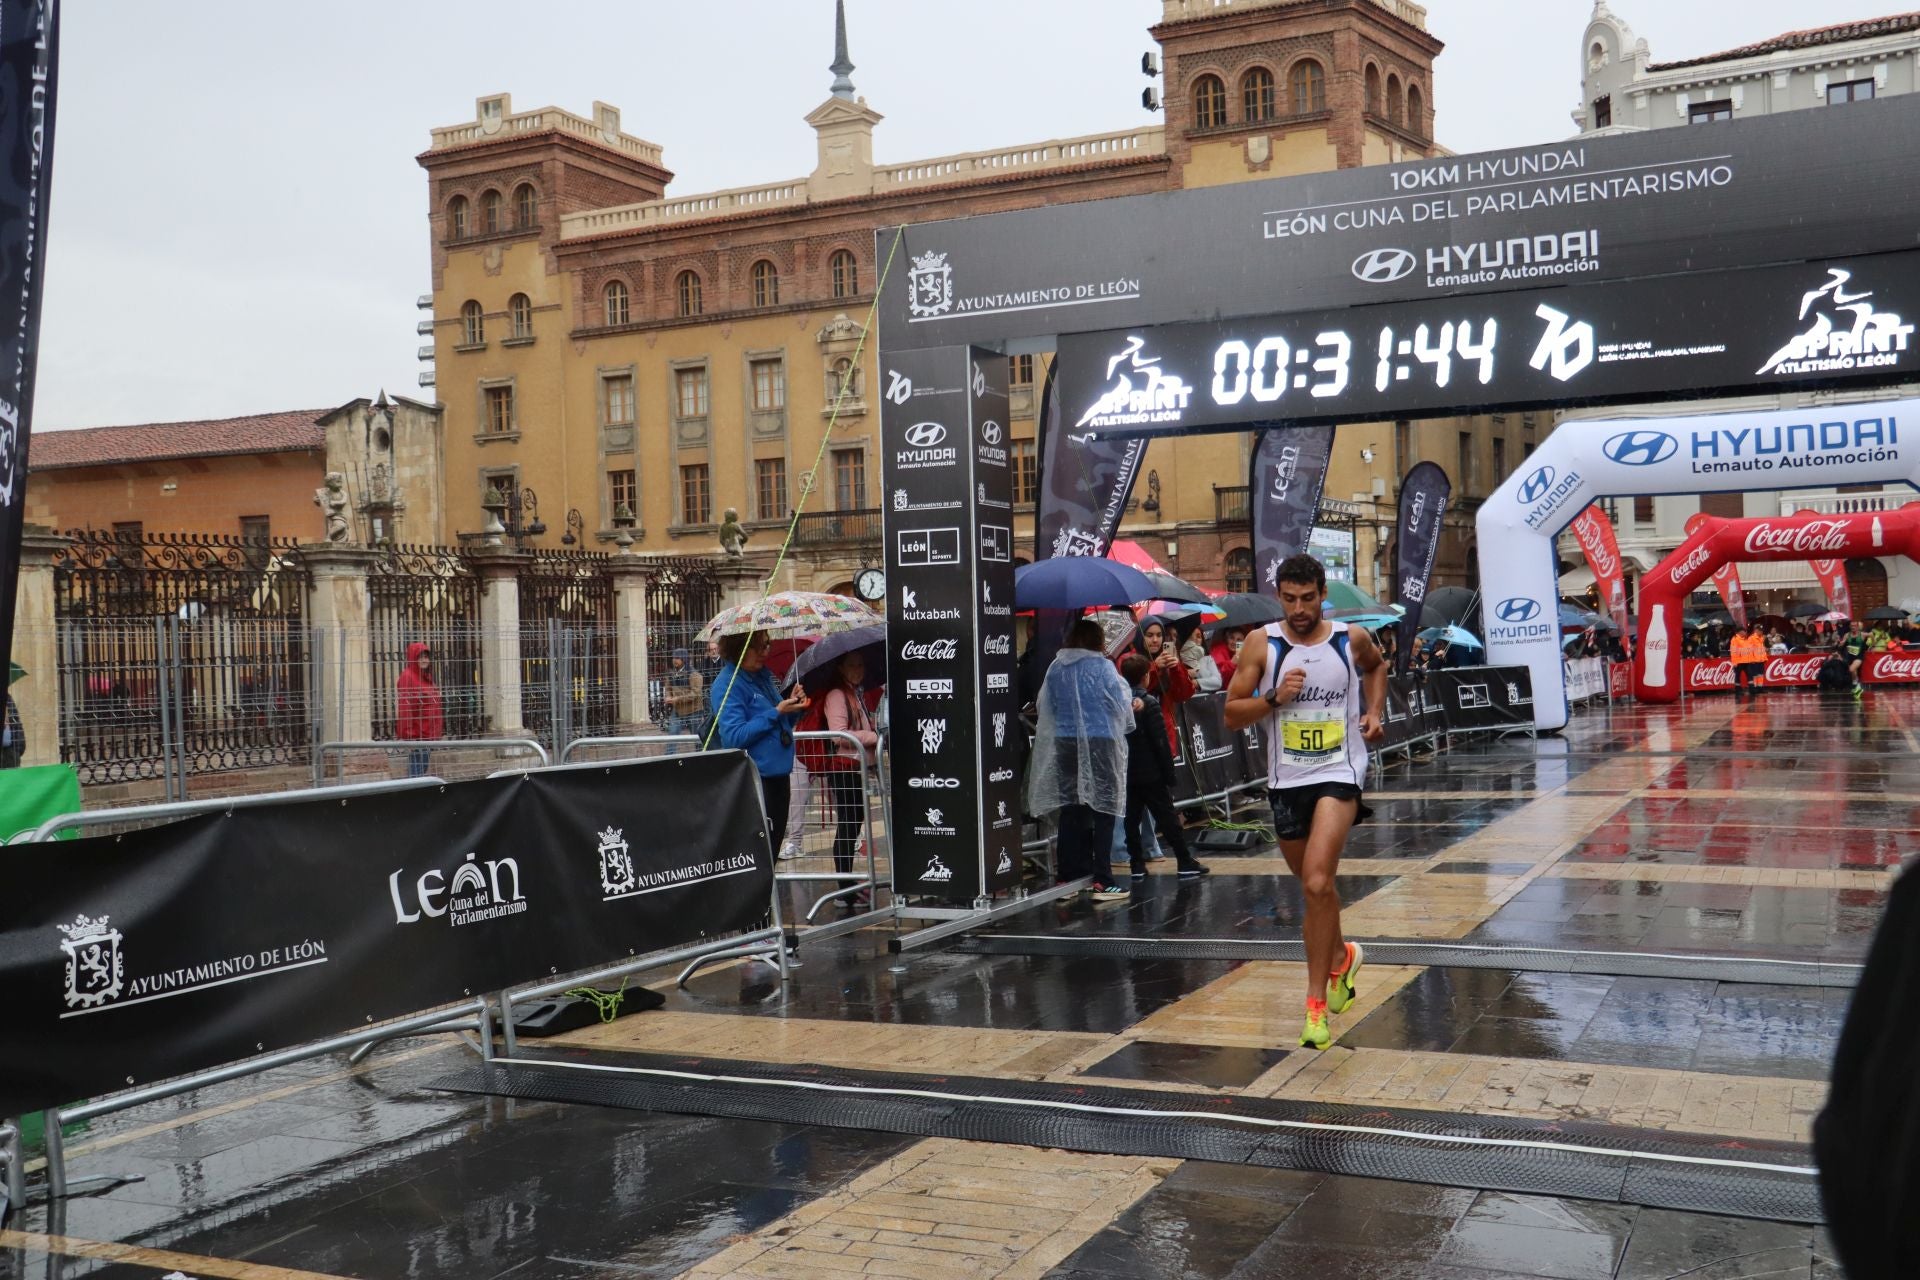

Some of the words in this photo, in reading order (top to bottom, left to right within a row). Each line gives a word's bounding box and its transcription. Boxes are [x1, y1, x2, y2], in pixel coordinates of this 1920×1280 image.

[1390, 164, 1460, 191] 10KM
[1466, 148, 1585, 182] HYUNDAI
[1263, 212, 1327, 239] LEÓN
[1333, 206, 1405, 231] CUNA
[1412, 200, 1459, 222] DEL
[1466, 165, 1733, 216] PARLAMENTARISMO
[1426, 229, 1599, 274] HYUNDAI
[1426, 269, 1496, 287] Lemauto
[1499, 258, 1599, 281] Automoción
[956, 286, 1071, 312] AYUNTAMIENTO
[1075, 284, 1095, 298] DE
[1100, 277, 1140, 296] LEÓN
[1211, 317, 1498, 406] 00:31:44
[1774, 357, 1854, 374] ATLETISMO
[1856, 353, 1897, 367] LEÓN
[1090, 412, 1149, 427] ATLETISMO
[1150, 410, 1180, 422] LEÓN
[1691, 417, 1898, 459] HYUNDAI
[897, 448, 956, 463] HYUNDAI
[979, 445, 1006, 461] HYUNDAI
[1692, 459, 1773, 474] Lemauto
[1779, 447, 1899, 469] Automoción
[1524, 471, 1580, 526] HYUNDAI
[902, 541, 926, 553] LEÓN
[1744, 519, 1852, 554] Coca-Cola
[1671, 544, 1709, 584] Coca-Cola
[903, 608, 961, 620] kutxabank
[984, 604, 1011, 615] kutxabank
[1490, 623, 1551, 638] HYUNDAI
[901, 639, 958, 660] Coca-Cola
[984, 635, 1010, 655] Coca-Cola
[1300, 730, 1324, 750] 50
[634, 864, 713, 888] AYUNTAMIENTO
[715, 860, 727, 872] DE
[727, 853, 755, 868] LEÓN
[449, 897, 473, 912] Cuna
[474, 891, 489, 905] del
[450, 901, 527, 927] Parlamentarismo
[128, 953, 255, 997] AYUNTAMIENTO
[260, 949, 281, 967] DE
[285, 939, 326, 962] LEÓN
